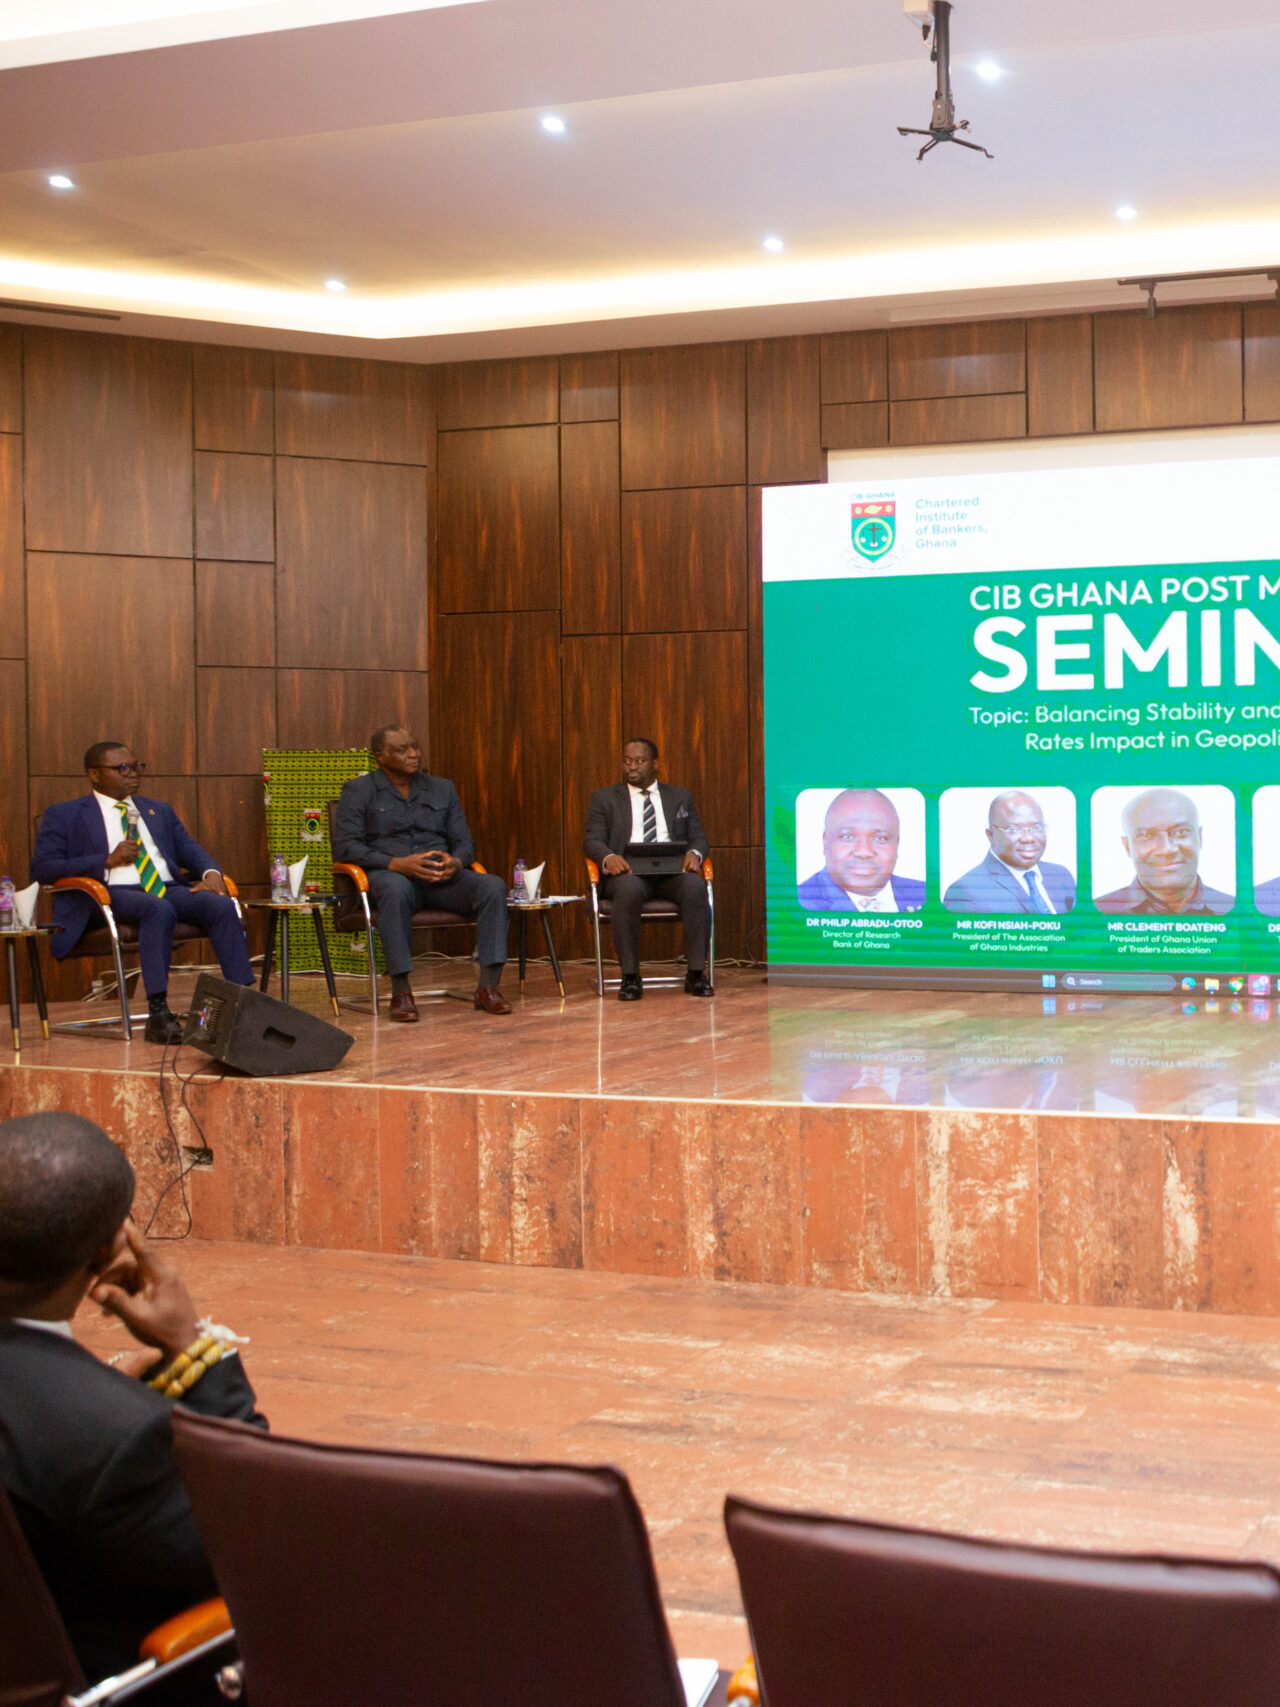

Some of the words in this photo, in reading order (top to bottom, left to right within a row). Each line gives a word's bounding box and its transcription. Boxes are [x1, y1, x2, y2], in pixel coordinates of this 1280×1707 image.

[865, 490, 896, 499] GHANA
[915, 496, 980, 509] Chartered
[915, 511, 968, 523] Institute
[915, 525, 929, 536] of
[931, 523, 988, 535] Bankers,
[915, 538, 957, 549] Ghana
[969, 584, 1022, 611] CIB
[1028, 580, 1154, 609] GHANA
[1160, 574, 1250, 603] POST
[969, 706, 1029, 727] Topic:
[1035, 703, 1140, 727] Balancing
[1146, 701, 1235, 724] Stability
[1025, 732, 1084, 751] Rates
[1090, 730, 1165, 753] Impact
[1171, 730, 1190, 748] in
[806, 918, 820, 927] DR
[821, 918, 850, 927] PHILIP
[851, 919, 923, 928] ABRADU-OTOO
[957, 921, 972, 929] MR
[974, 921, 996, 929] KOFI
[998, 921, 1061, 930] NSIAH-POKU
[1108, 922, 1123, 931] MR
[1125, 922, 1174, 931] CLEMENT
[1175, 923, 1227, 932] BOATENG
[822, 930, 853, 938] Director
[855, 930, 864, 938] of
[865, 931, 901, 939] Research
[953, 932, 990, 940] President
[1002, 933, 1017, 941] The
[1019, 933, 1066, 942] Association
[1151, 935, 1160, 943] of
[1162, 935, 1191, 943] Ghana
[833, 940, 852, 948] Bank
[854, 940, 862, 948] of
[864, 941, 890, 949] Ghana
[970, 943, 979, 951] of
[980, 943, 1007, 951] Ghana
[1009, 944, 1048, 952] Industries
[1117, 945, 1127, 953] of
[1129, 945, 1161, 953] Traders
[1162, 946, 1211, 954] Association
